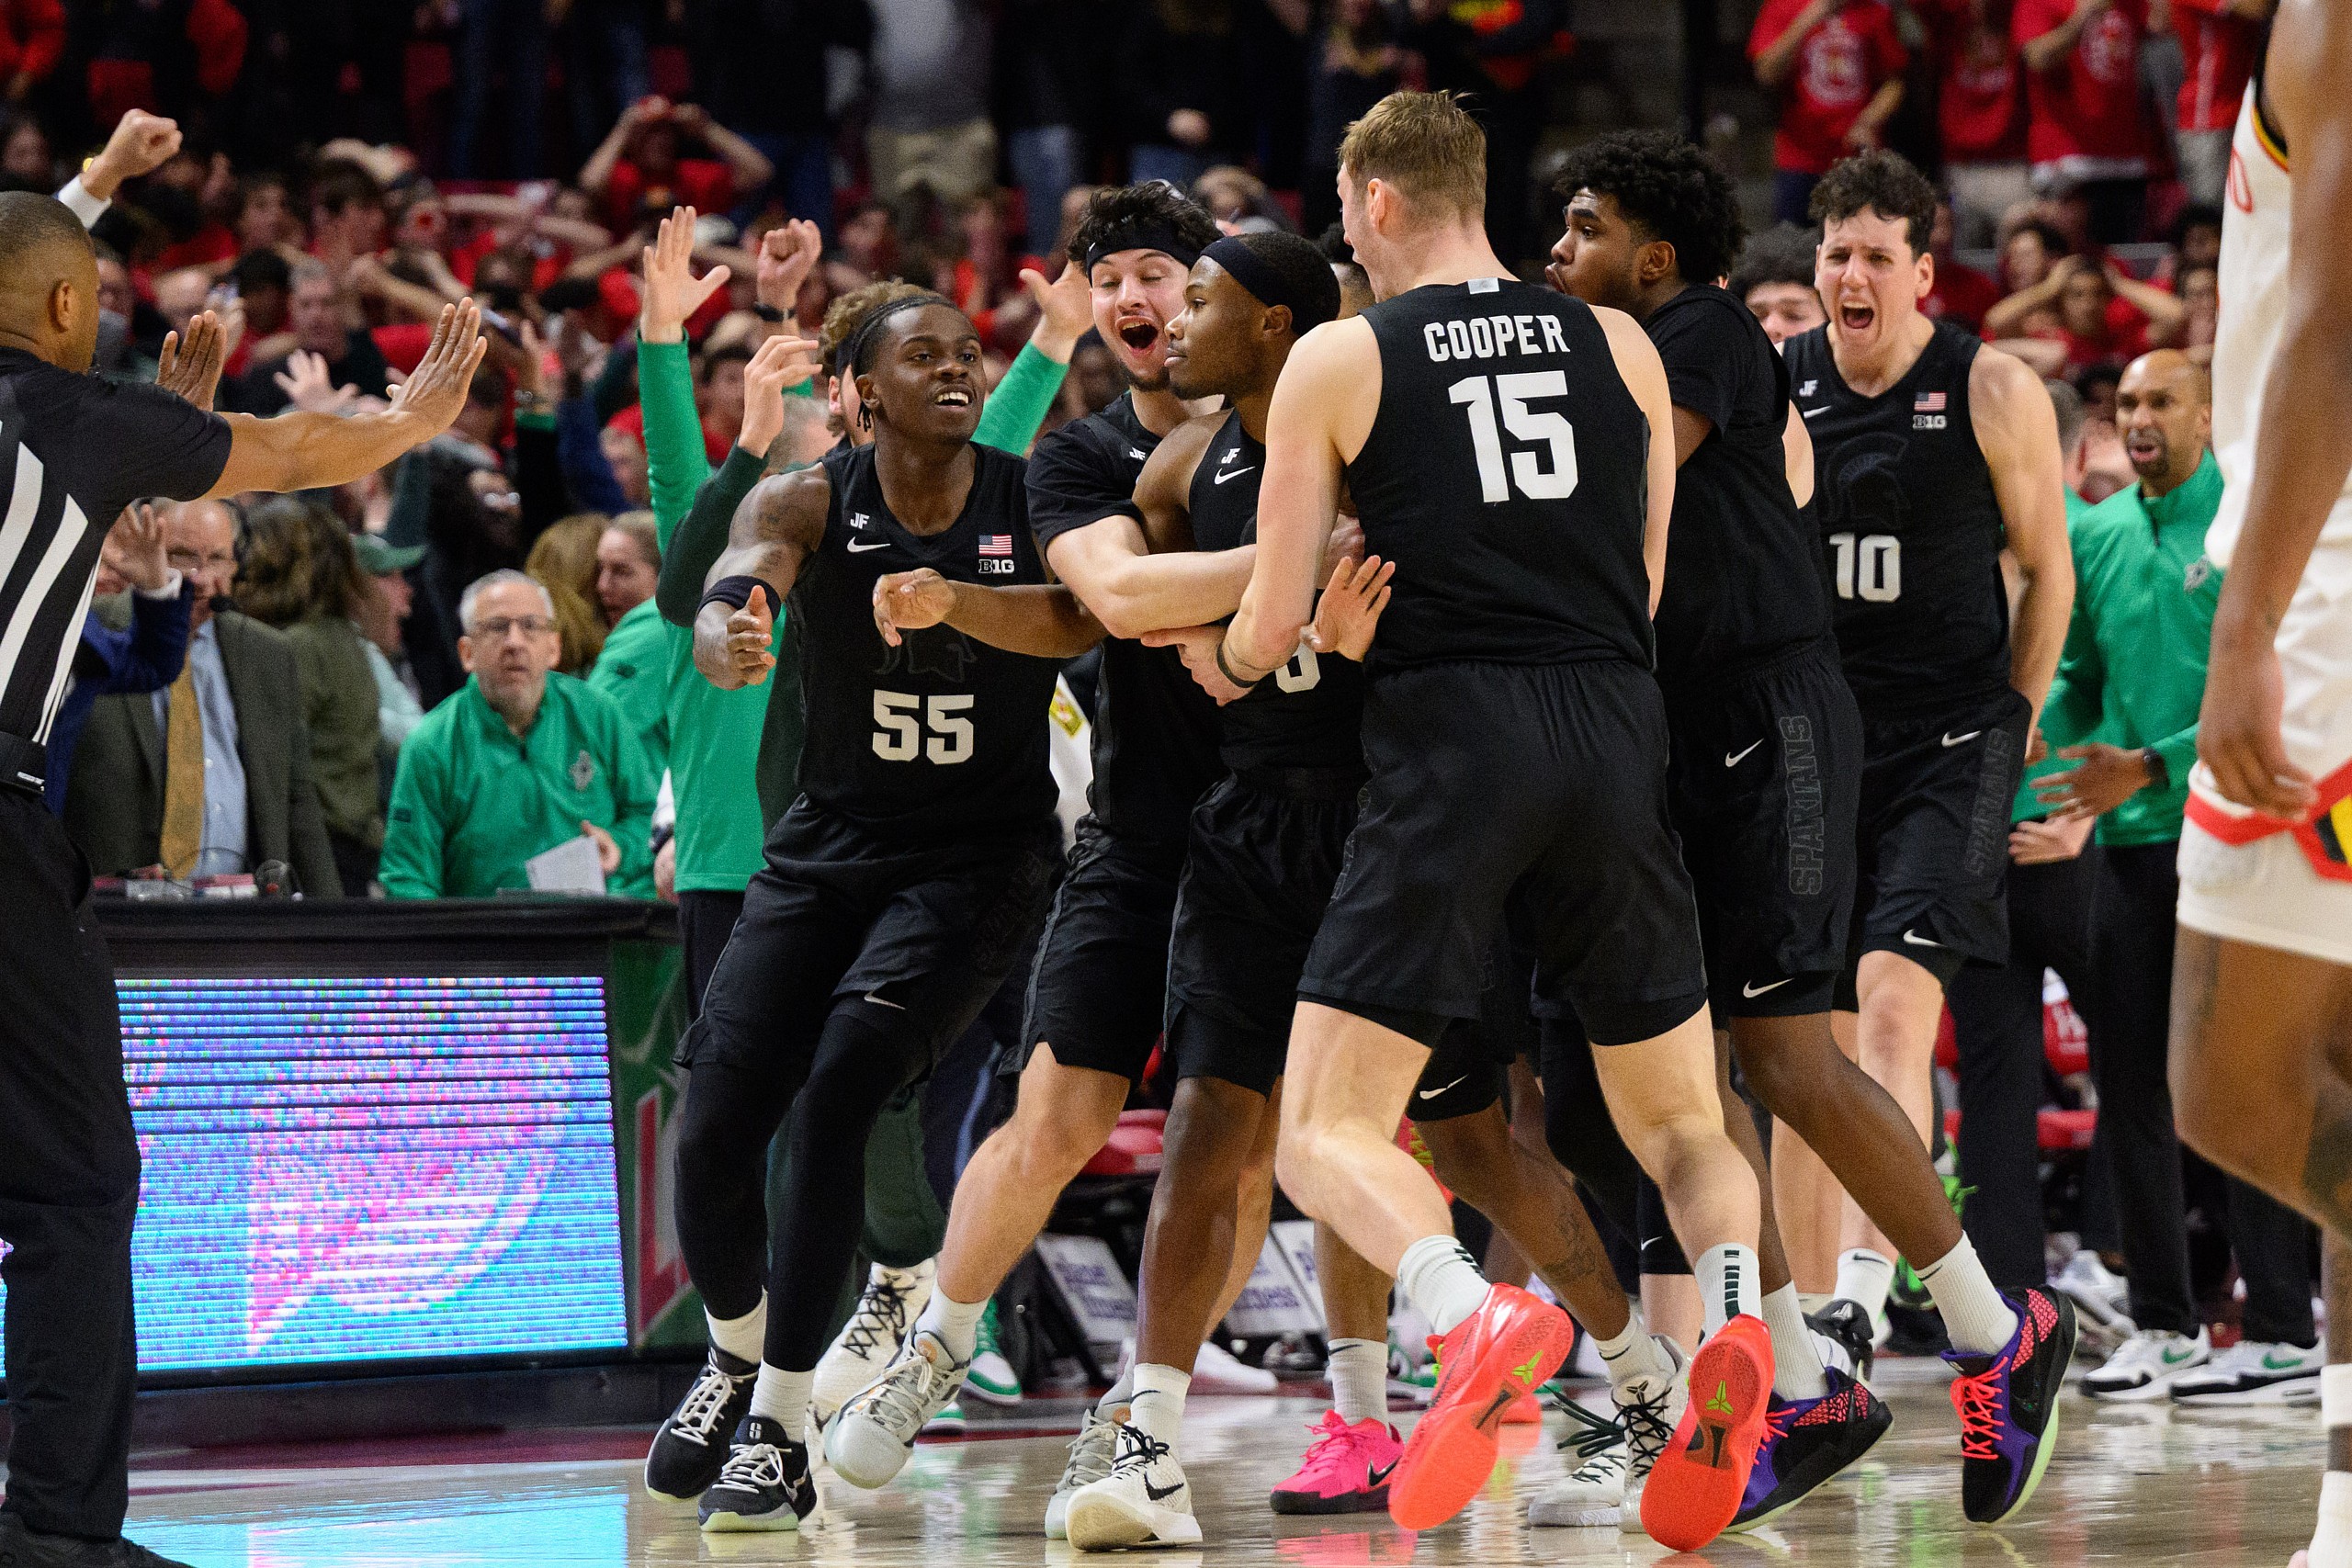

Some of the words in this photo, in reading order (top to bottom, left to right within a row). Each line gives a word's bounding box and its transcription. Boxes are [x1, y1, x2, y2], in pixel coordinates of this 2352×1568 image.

[1424, 314, 1570, 362] COOPER
[1799, 379, 1818, 397] JF
[1129, 447, 1146, 460] JF
[1221, 448, 1240, 463] JF
[1448, 370, 1578, 502] 15
[850, 513, 869, 529] JF
[1829, 533, 1901, 603] 10
[873, 689, 974, 764] 55
[1779, 715, 1825, 895] SPARTANS
